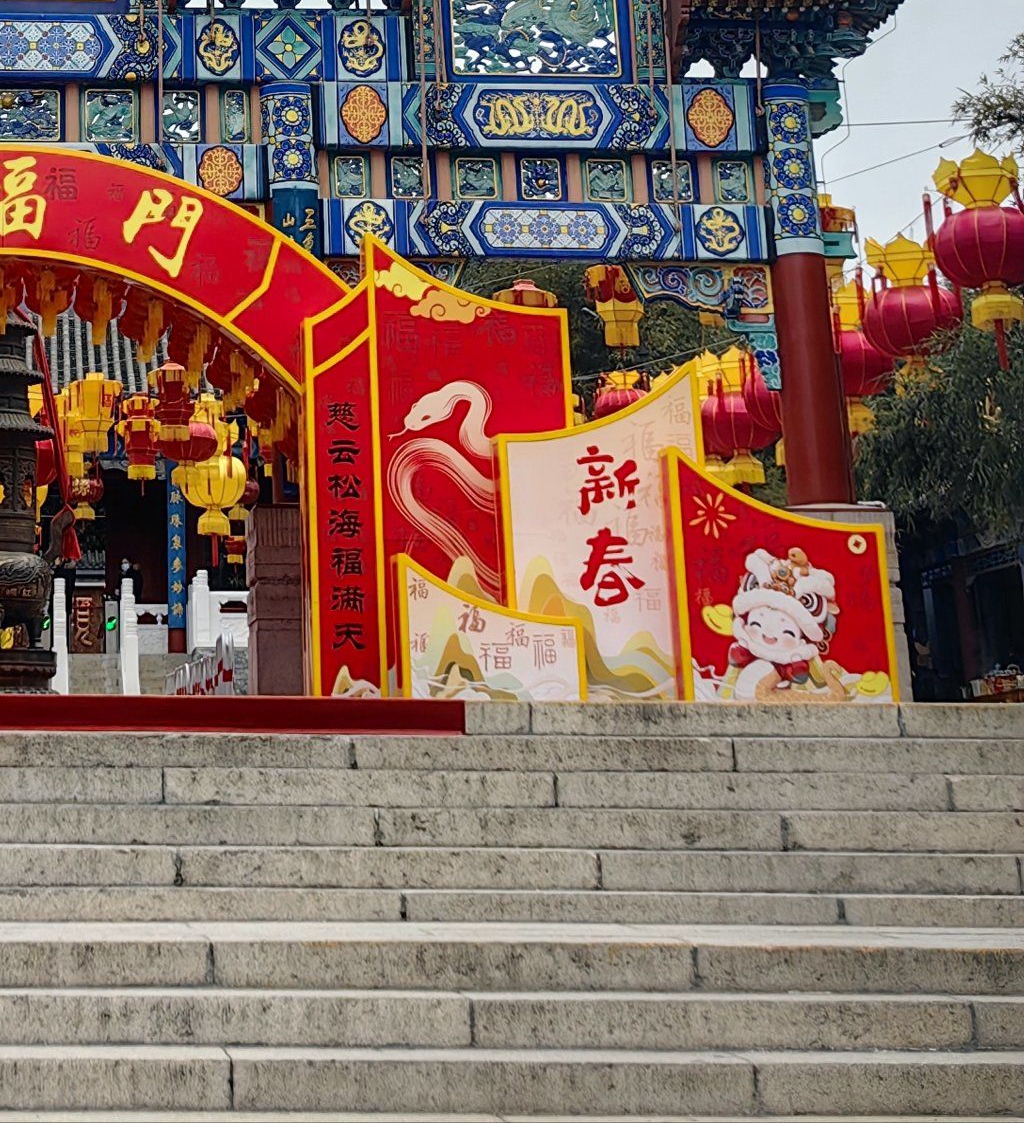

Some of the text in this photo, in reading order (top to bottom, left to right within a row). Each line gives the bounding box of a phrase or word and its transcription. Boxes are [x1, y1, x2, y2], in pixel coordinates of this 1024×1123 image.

[326, 401, 365, 650] 慈云松海福满天
[576, 445, 645, 607] 新春
[409, 578, 429, 601] 福
[458, 604, 487, 633] 福
[479, 642, 512, 671] 福
[532, 634, 557, 671] 福
